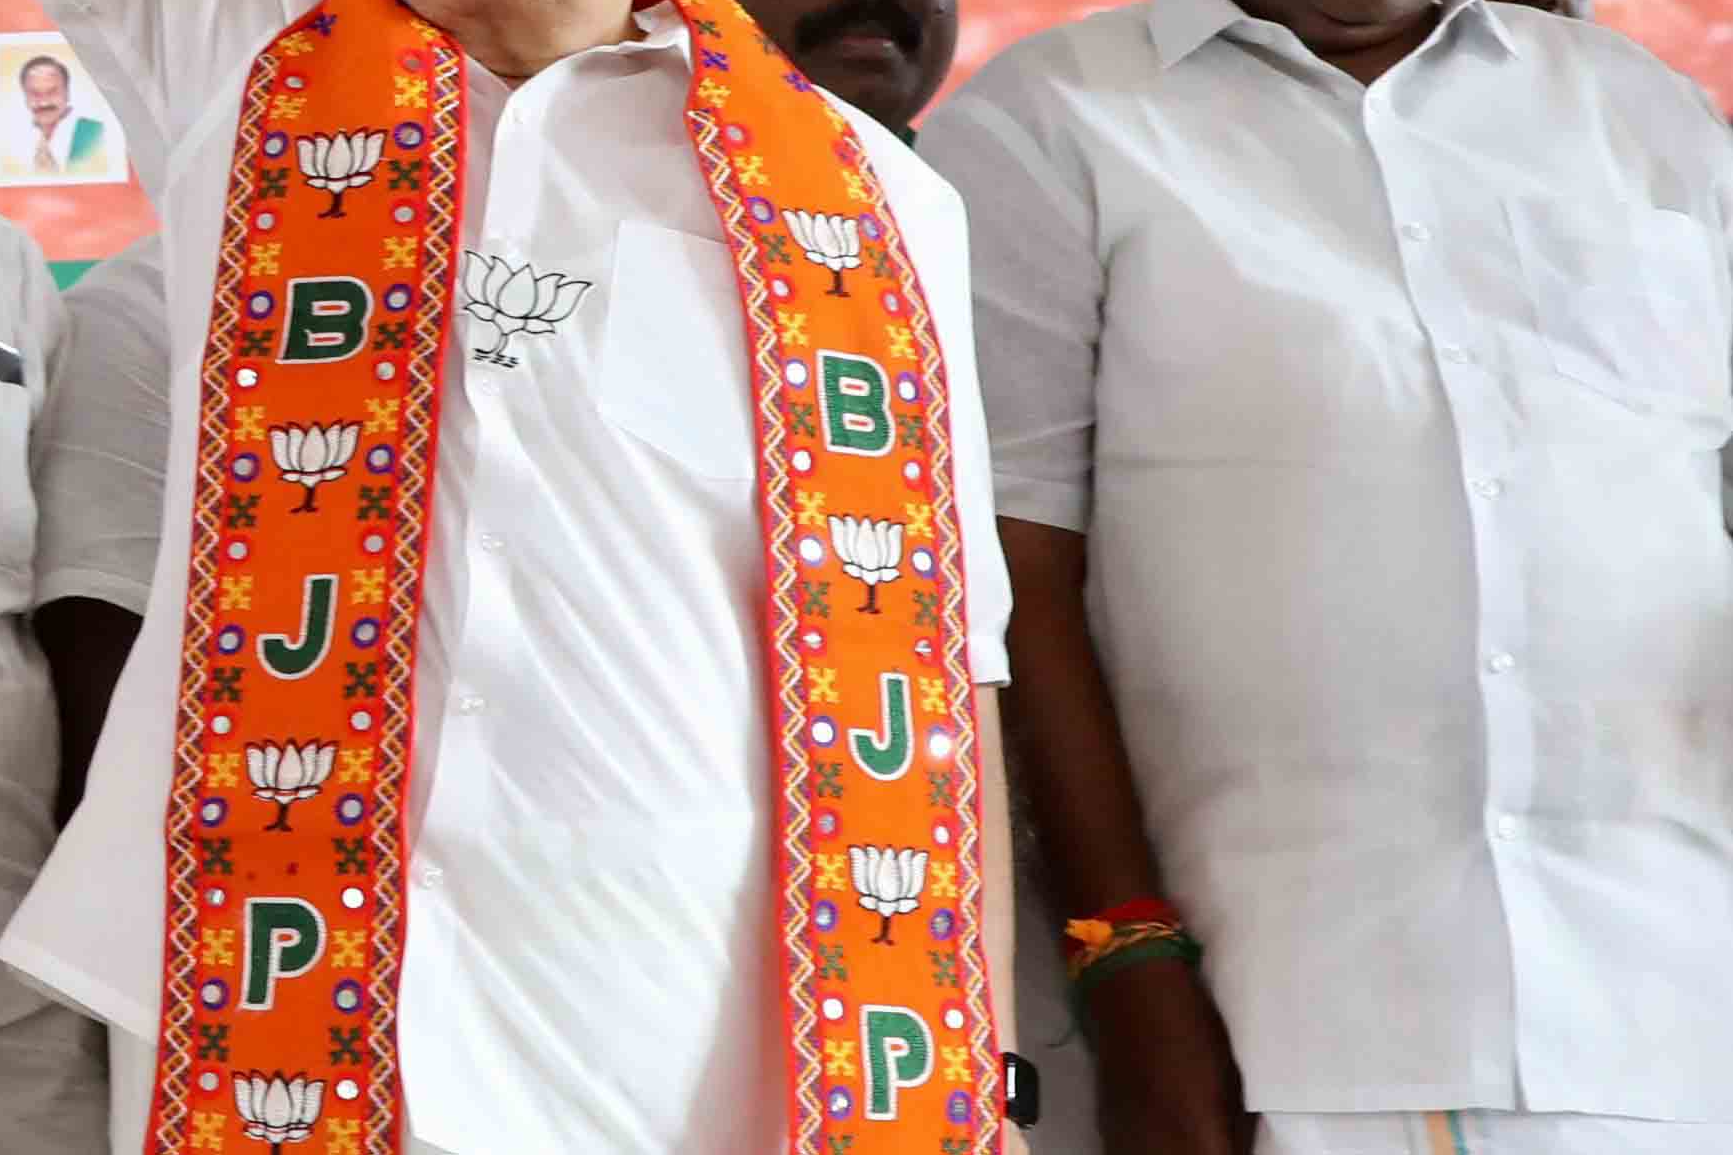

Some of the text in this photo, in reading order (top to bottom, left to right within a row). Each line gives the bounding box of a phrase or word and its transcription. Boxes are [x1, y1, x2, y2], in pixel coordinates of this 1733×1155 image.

[240, 277, 374, 1010] B J P
[816, 350, 934, 1120] B J P
